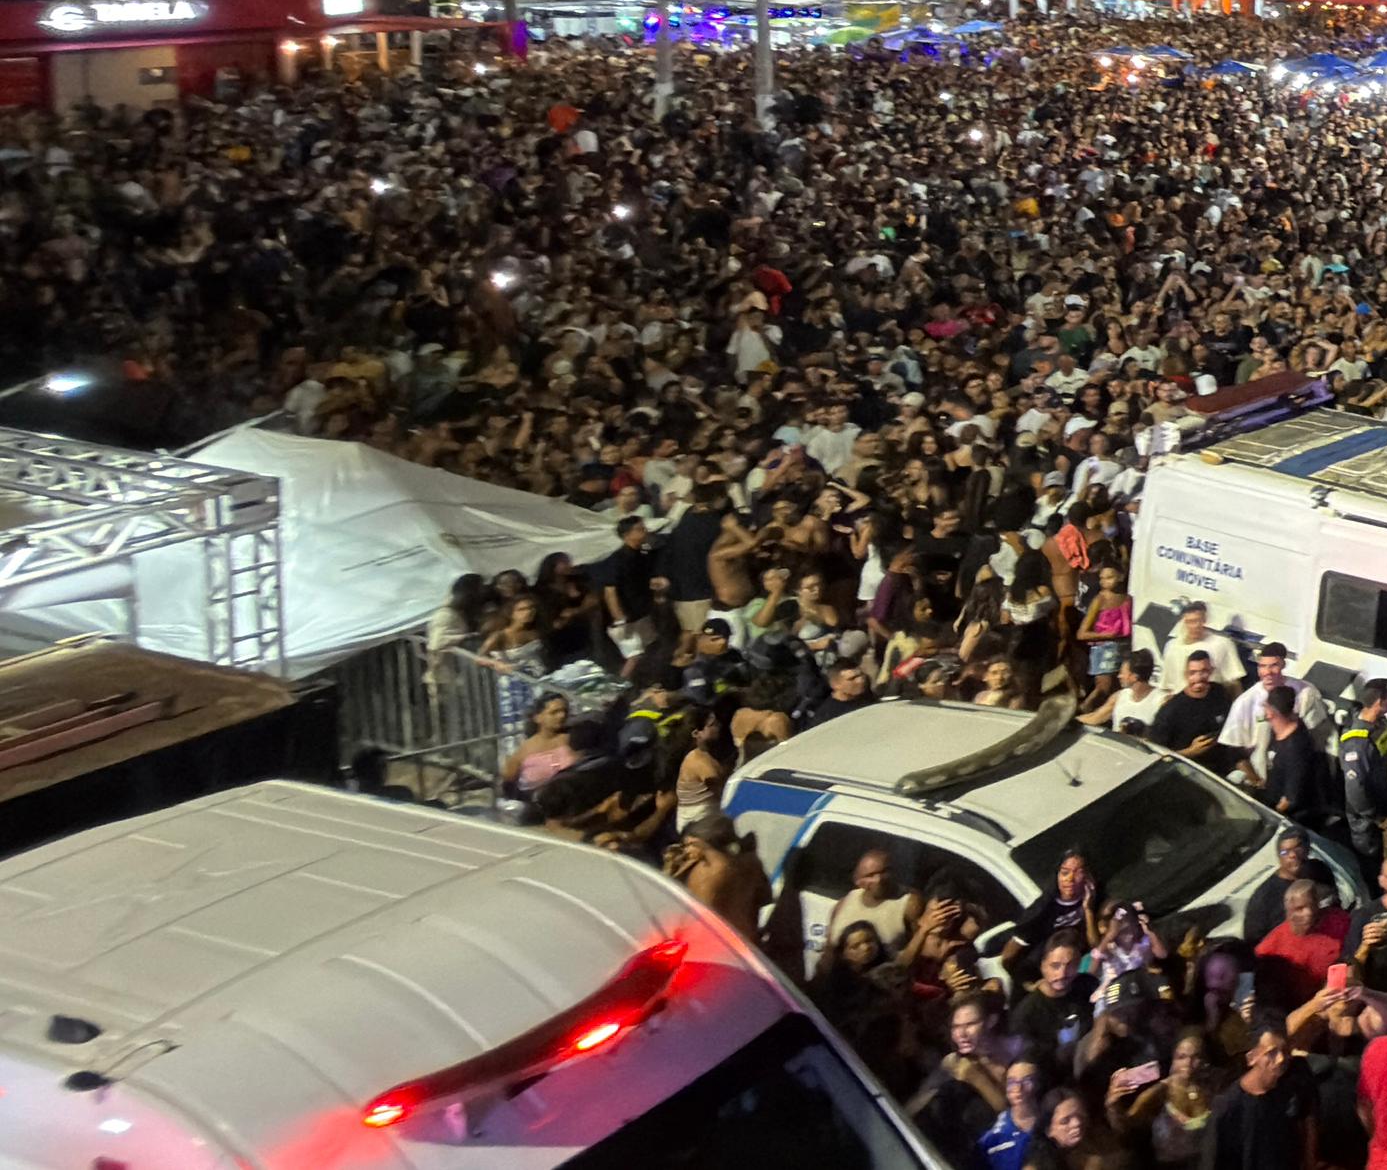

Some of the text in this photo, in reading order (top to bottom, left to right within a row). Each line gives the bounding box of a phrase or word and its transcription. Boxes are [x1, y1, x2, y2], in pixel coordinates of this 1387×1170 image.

[1185, 536, 1220, 556] BASE
[1156, 545, 1243, 579] COMUNITÁRIA
[1175, 568, 1220, 592] MÓVEL
